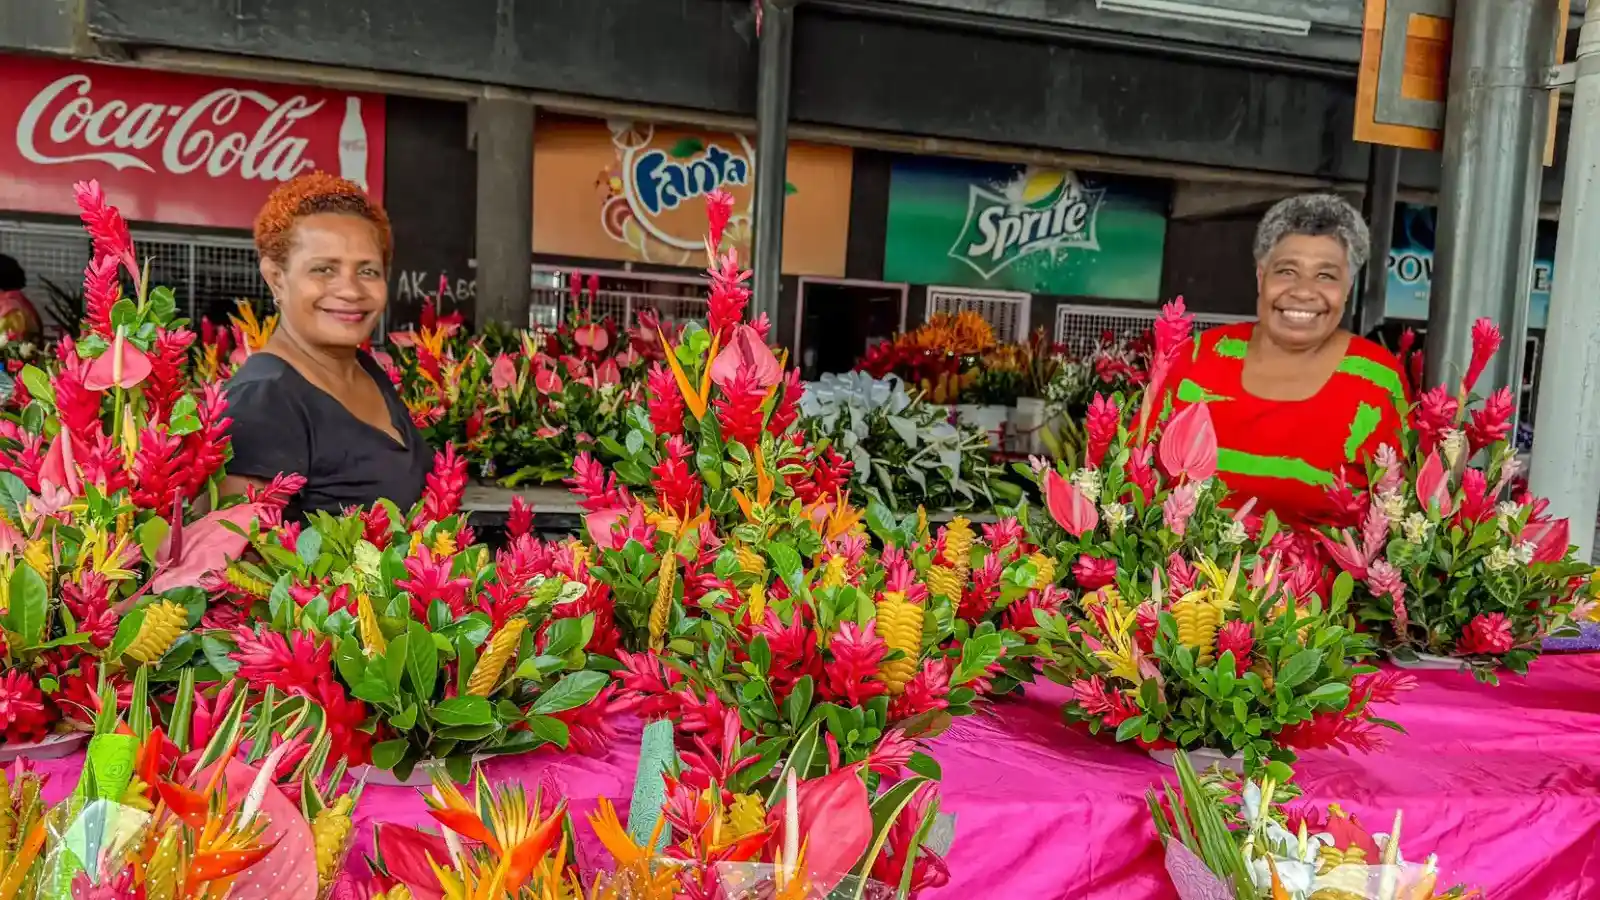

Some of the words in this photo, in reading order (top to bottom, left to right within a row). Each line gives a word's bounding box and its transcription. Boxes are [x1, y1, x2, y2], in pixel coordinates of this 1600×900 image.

[16, 74, 326, 181] Coca-Cola
[634, 145, 748, 215] Fanta
[967, 185, 1088, 262] Sprite
